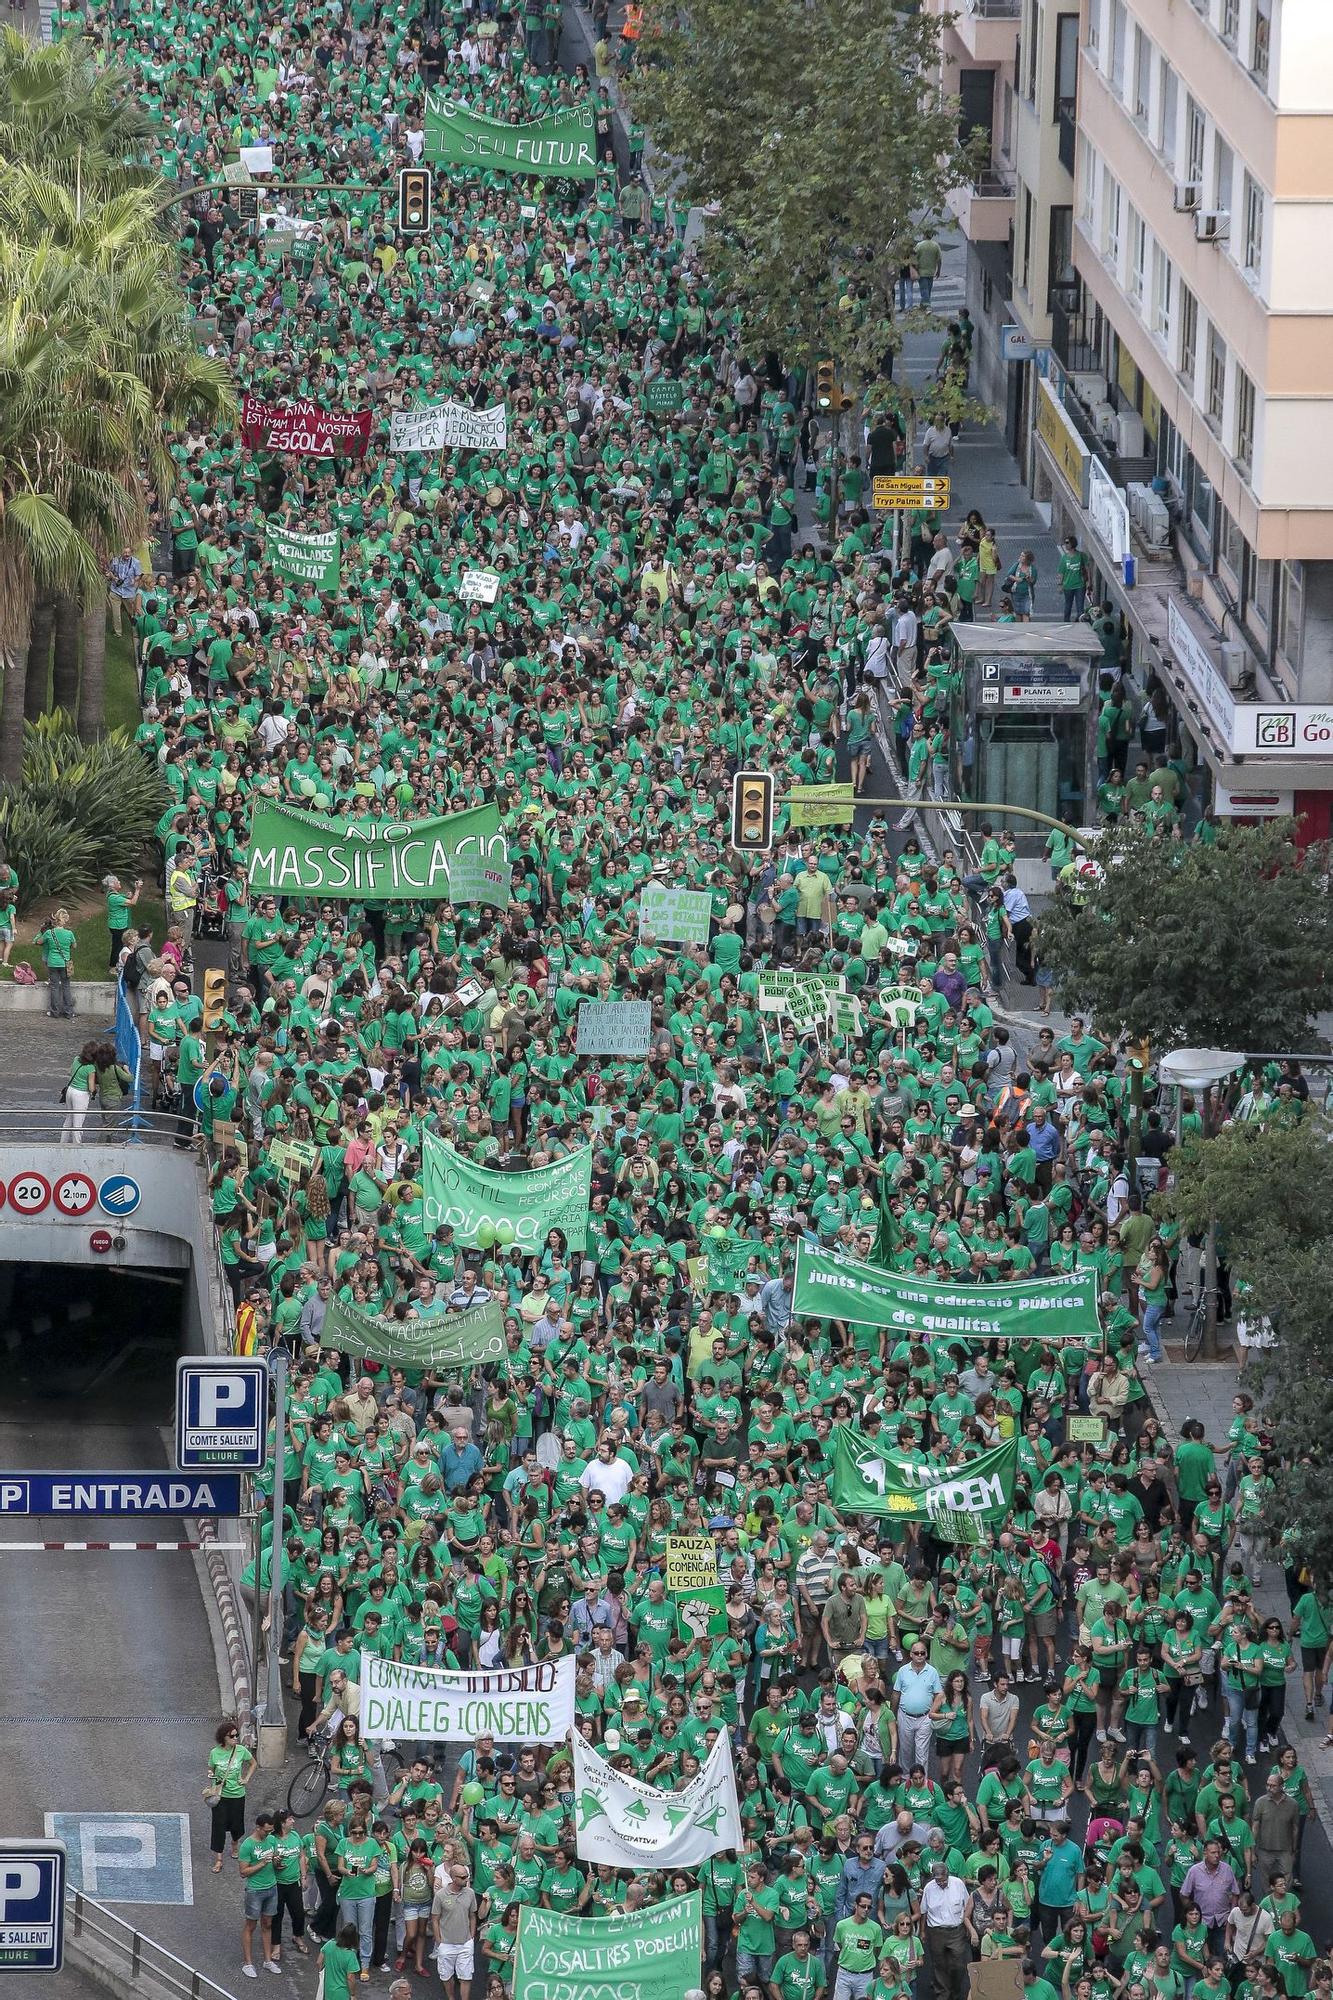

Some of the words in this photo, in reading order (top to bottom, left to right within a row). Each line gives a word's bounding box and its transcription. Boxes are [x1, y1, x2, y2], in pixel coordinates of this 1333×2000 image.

[423, 129, 450, 153] EL
[460, 133, 506, 156] SEU
[516, 139, 596, 166] FUTUR
[293, 419, 307, 429] LA
[317, 422, 361, 436] NOSTRA
[417, 423, 441, 437] PER
[266, 431, 334, 454] ESCOLA
[420, 437, 437, 448] LA
[900, 483, 922, 491] Miguel
[896, 497, 921, 505] Palma
[278, 544, 333, 562] RETALLADES
[986, 666, 996, 679] P
[342, 823, 413, 844] NO
[760, 973, 775, 981] Per
[796, 976, 839, 987] edció
[788, 988, 797, 998] el
[804, 982, 821, 993] TIL
[904, 990, 920, 1003] TIL
[791, 997, 807, 1010] per
[812, 993, 822, 1002] la
[431, 1162, 460, 1191] NO
[466, 1185, 477, 1195] AL
[480, 1184, 506, 1204] TIL
[18, 1187, 41, 1200] 20
[519, 1183, 586, 1206] RECURSOS
[540, 1225, 588, 1240] LMPART
[808, 1269, 856, 1289] junts
[862, 1281, 891, 1296] per
[896, 1290, 928, 1304] una
[934, 1294, 1013, 1308] educació
[1018, 1295, 1085, 1311] pública
[892, 1309, 916, 1325] de
[922, 1314, 1001, 1333] qualitat
[199, 1376, 246, 1427] P
[189, 1435, 218, 1446] COMTE
[219, 1434, 254, 1446] SALLENT
[206, 1452, 238, 1460] LLIURE
[2, 1486, 22, 1509] P
[52, 1484, 216, 1510] ENTRADA
[670, 1539, 712, 1550] BAUZA
[682, 1553, 704, 1561] VULL
[670, 1576, 715, 1588] L'ESCOLA
[370, 1658, 437, 1689] CONTRA
[368, 1696, 449, 1733] DIÀLEG
[465, 1701, 551, 1737] CONSENS
[80, 1822, 156, 1891] P
[8, 1931, 48, 1944] SALLENT
[520, 1943, 630, 1977] VOSALTRES
[635, 1925, 699, 1960] PODEU!!!
